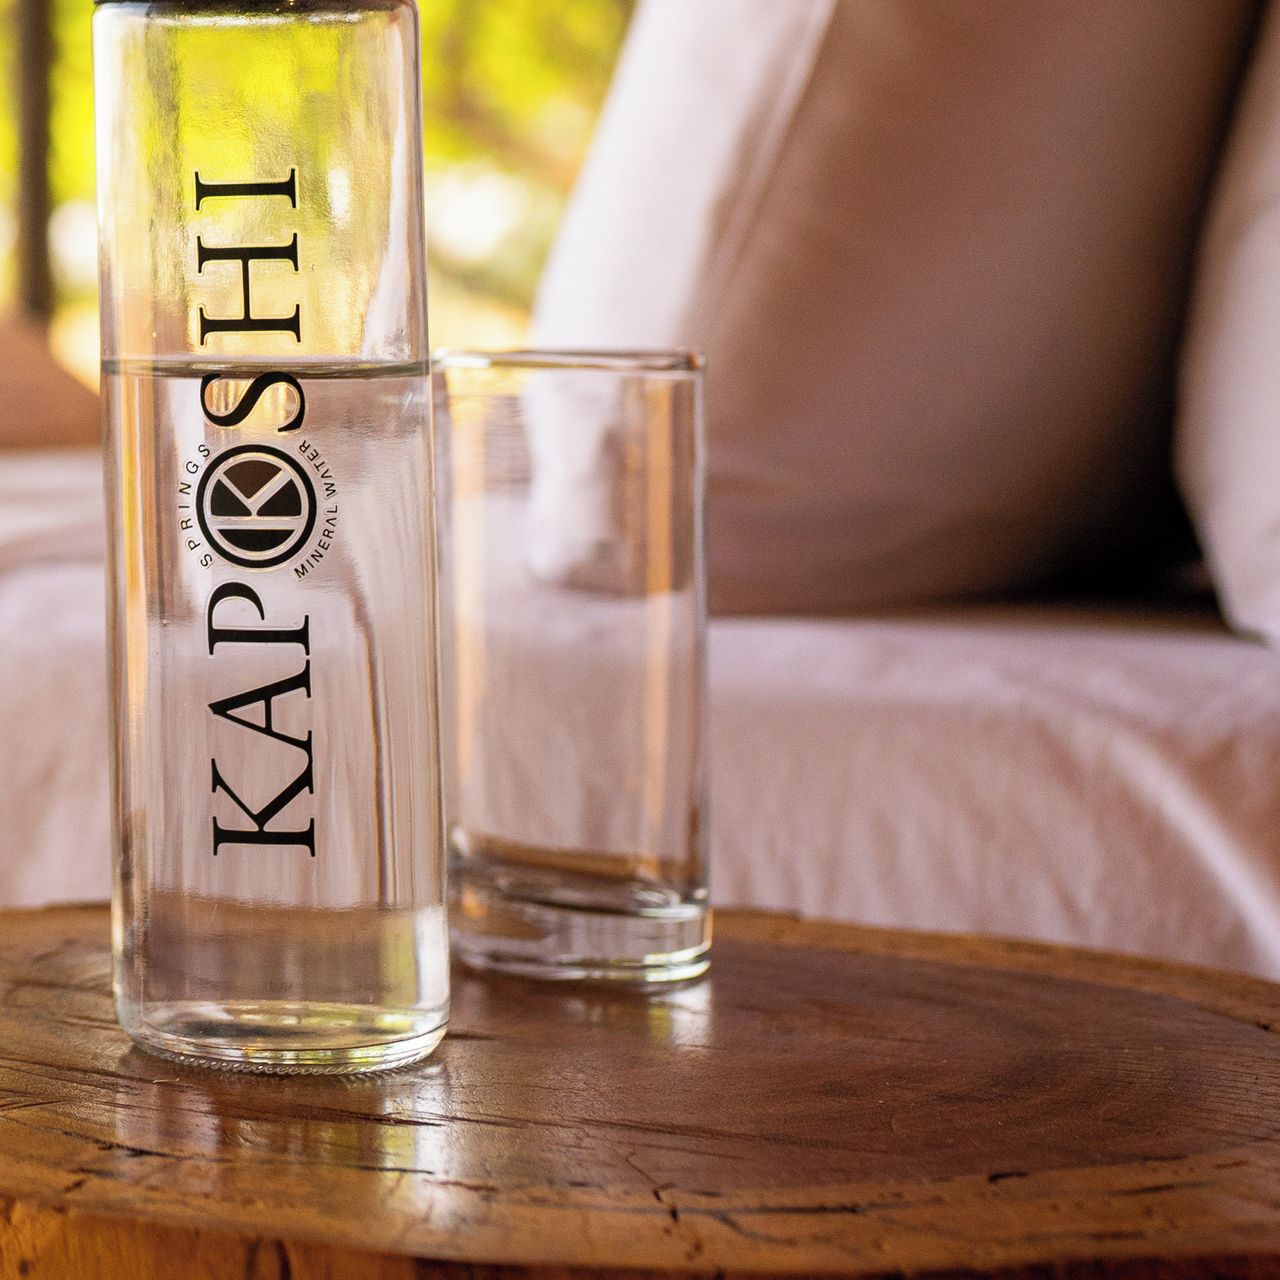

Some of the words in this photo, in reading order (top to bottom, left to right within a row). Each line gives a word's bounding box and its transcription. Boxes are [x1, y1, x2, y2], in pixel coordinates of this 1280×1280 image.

[178, 443, 213, 568] SPRINGS
[195, 167, 316, 857] KAPOSHI
[298, 439, 337, 500] WATER
[293, 504, 339, 579] MINERAL
